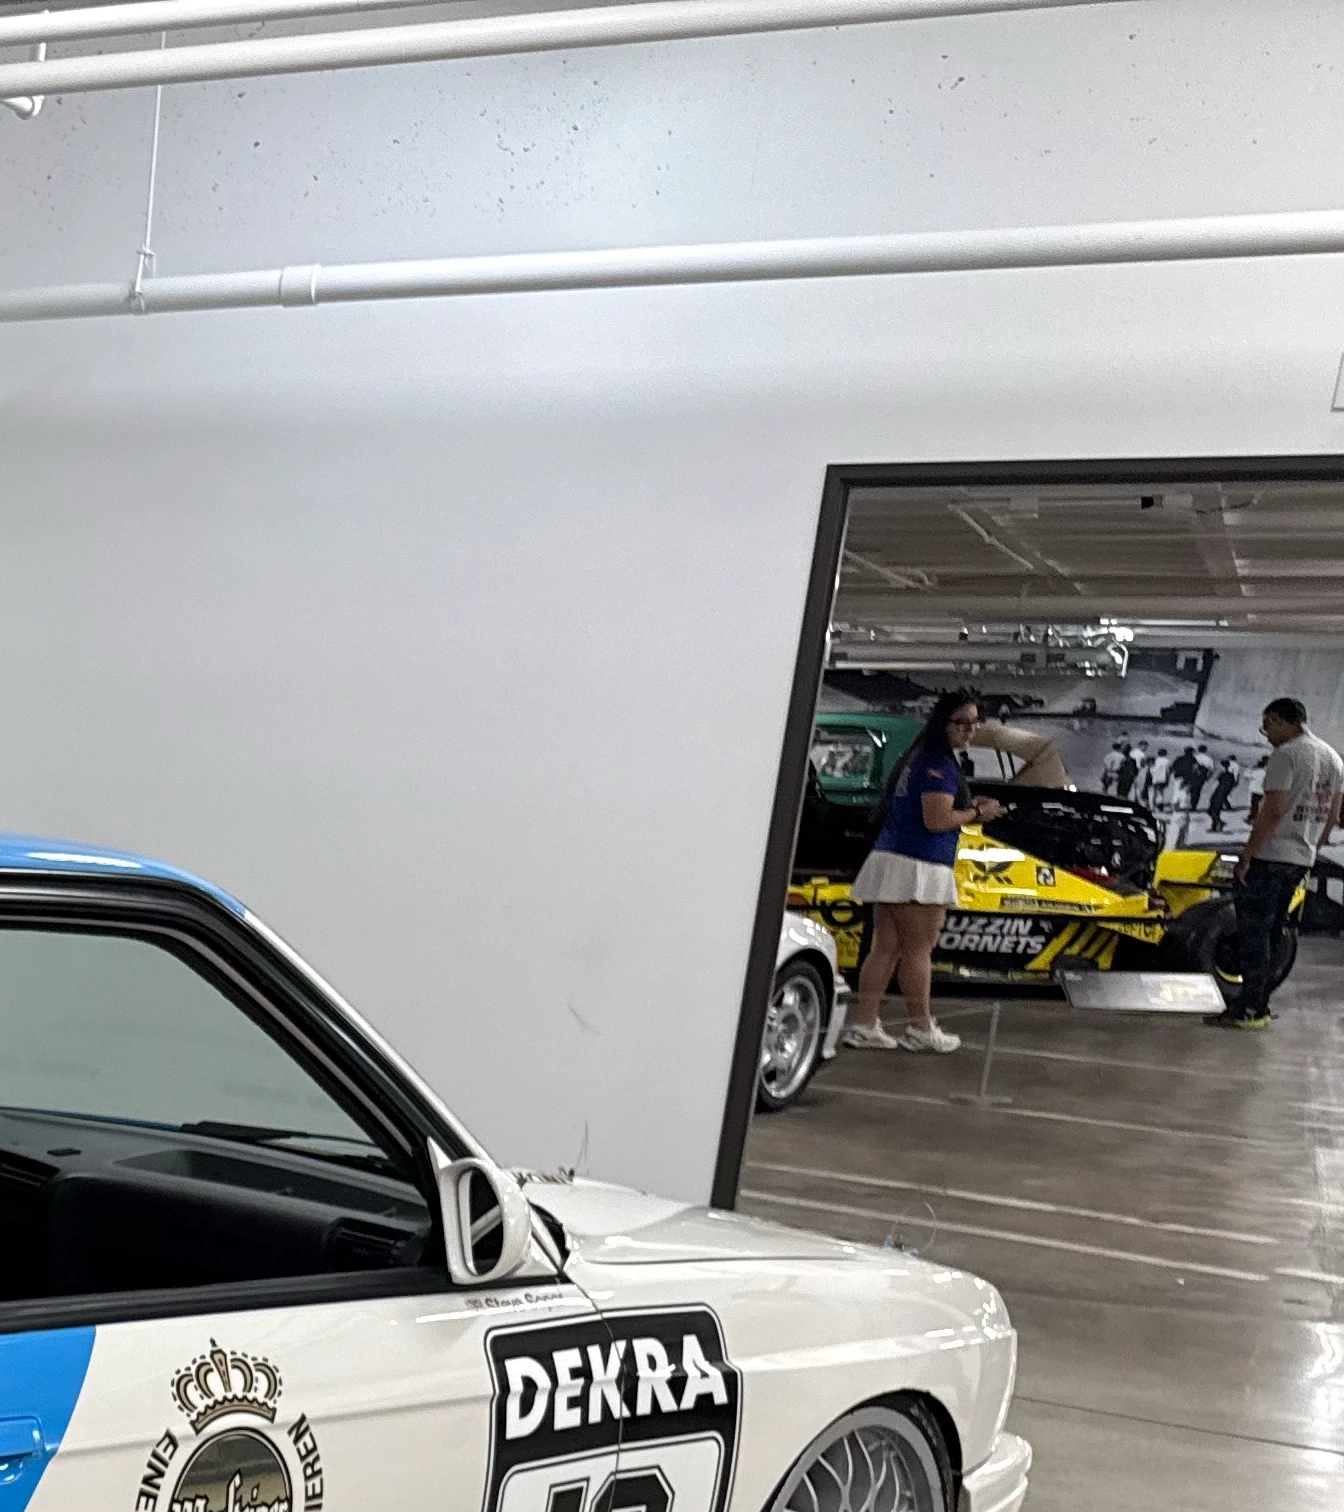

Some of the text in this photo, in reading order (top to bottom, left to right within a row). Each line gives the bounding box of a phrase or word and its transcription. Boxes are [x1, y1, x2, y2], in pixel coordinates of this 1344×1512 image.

[937, 932, 1045, 955] ORNETS
[944, 915, 1033, 935] UZZIN
[504, 1333, 730, 1441] DEKRA
[135, 1427, 180, 1512] EINE
